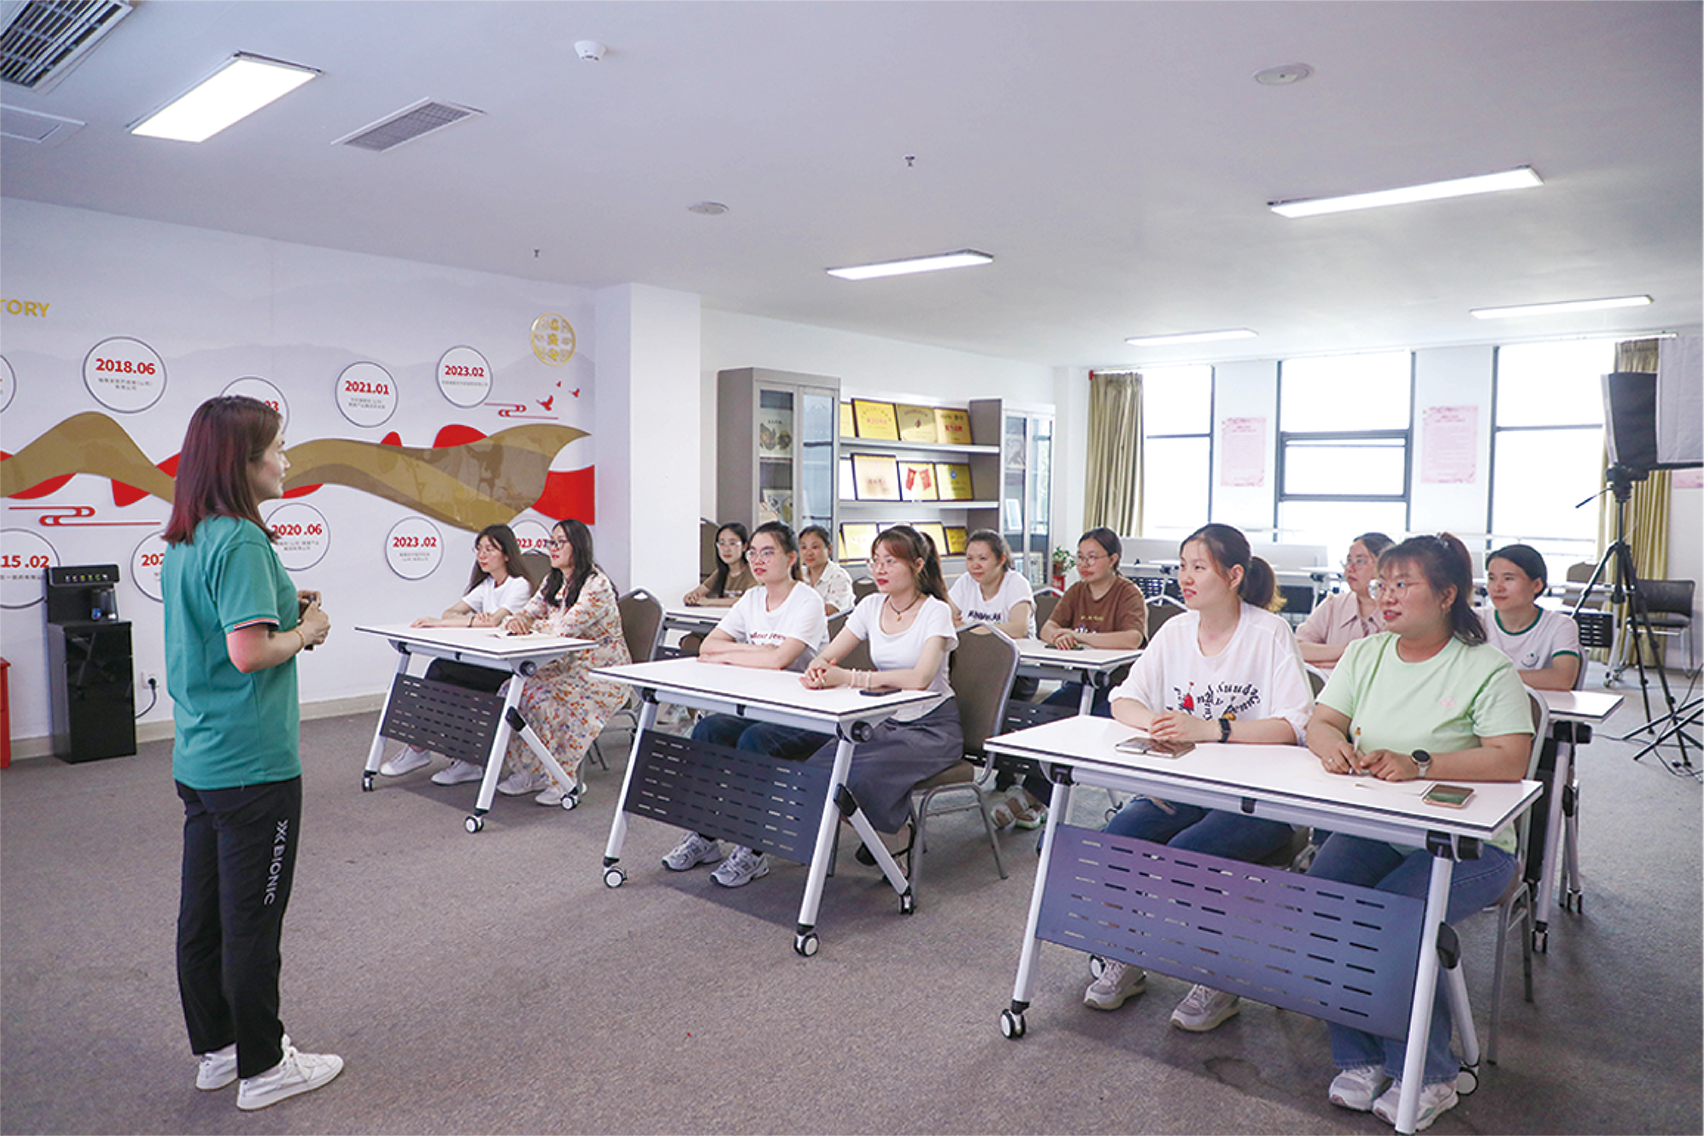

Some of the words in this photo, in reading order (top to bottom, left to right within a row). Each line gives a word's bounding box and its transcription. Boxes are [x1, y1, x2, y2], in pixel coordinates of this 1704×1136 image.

[95, 357, 156, 375] 2018.06
[444, 364, 485, 377] 2023.02
[345, 380, 390, 395] 2021.01
[271, 523, 323, 536] 2020.06
[393, 536, 437, 548] 2023.02
